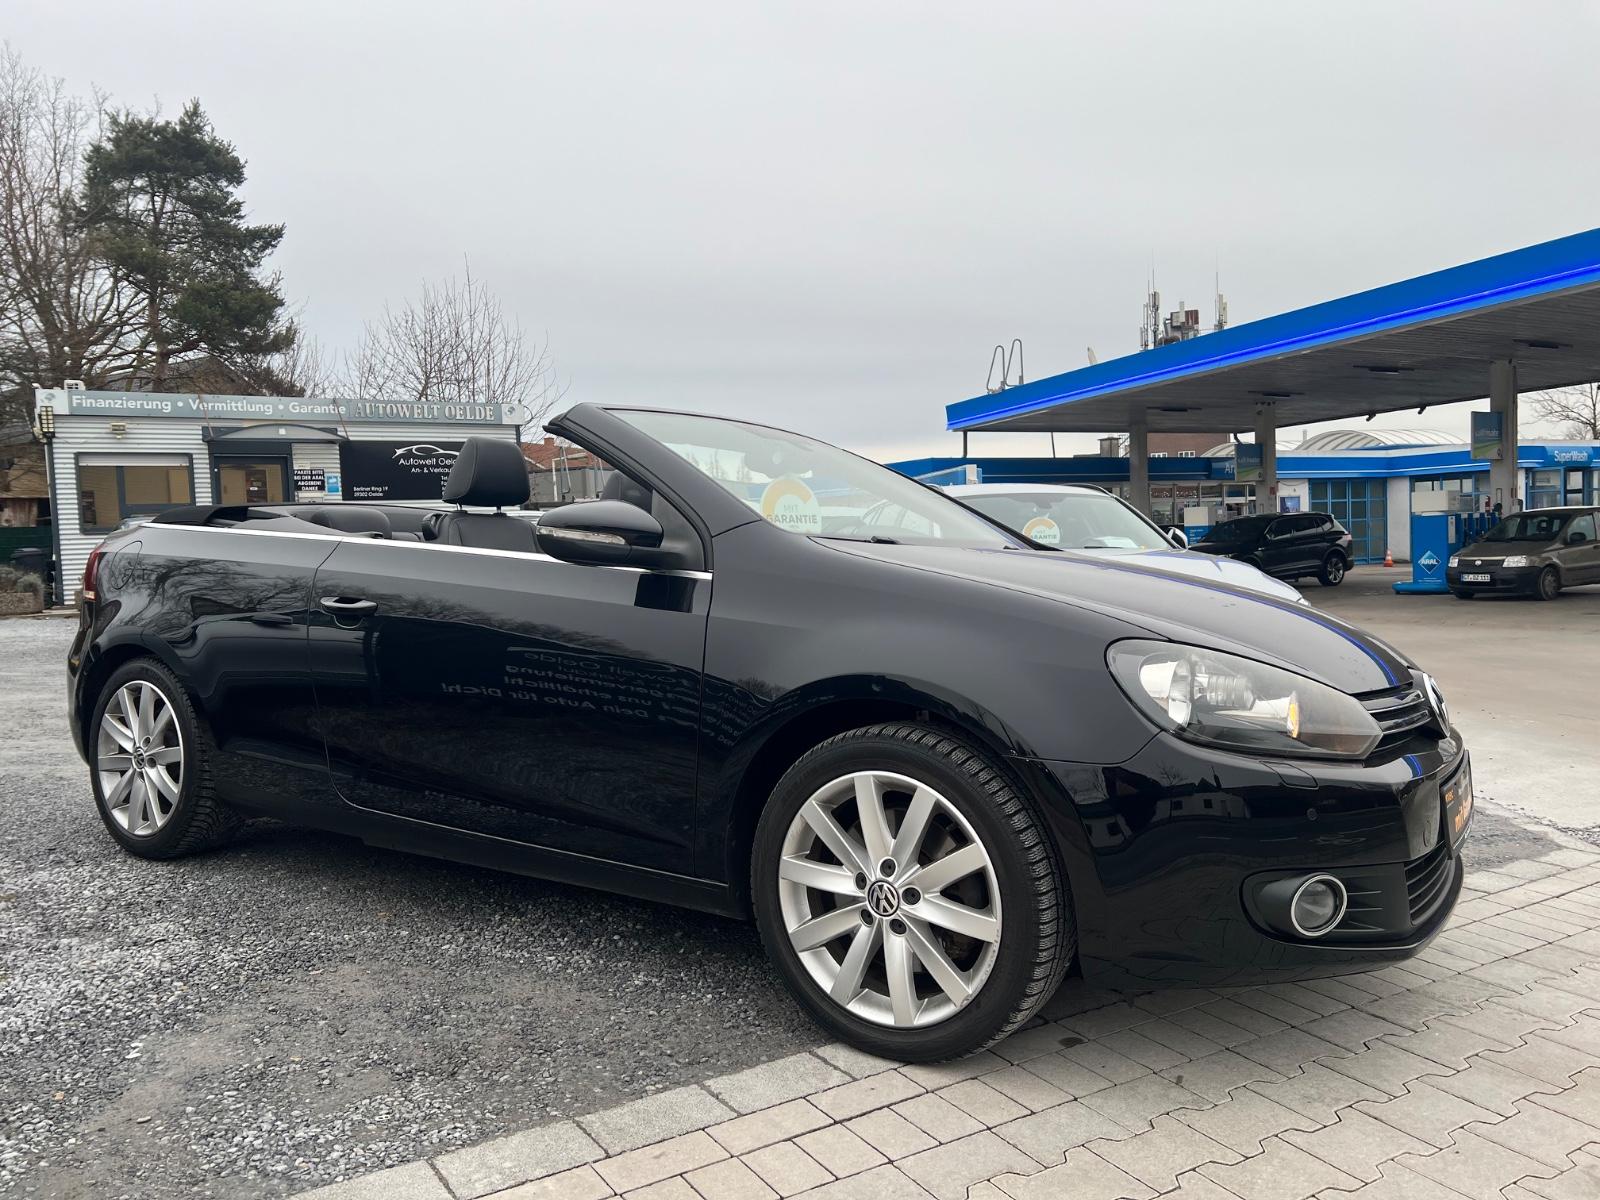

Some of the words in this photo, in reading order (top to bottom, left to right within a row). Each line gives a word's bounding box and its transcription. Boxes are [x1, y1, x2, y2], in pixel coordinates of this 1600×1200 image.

[71, 395, 172, 412] Finanzierung
[189, 398, 273, 415] Vermittlung
[288, 401, 347, 414] Garantie
[354, 402, 441, 419] AUTOWELT
[444, 405, 496, 421] OELDE
[398, 457, 436, 466] Autowelt
[783, 504, 799, 512] MIT
[767, 513, 818, 525] GARANTIE
